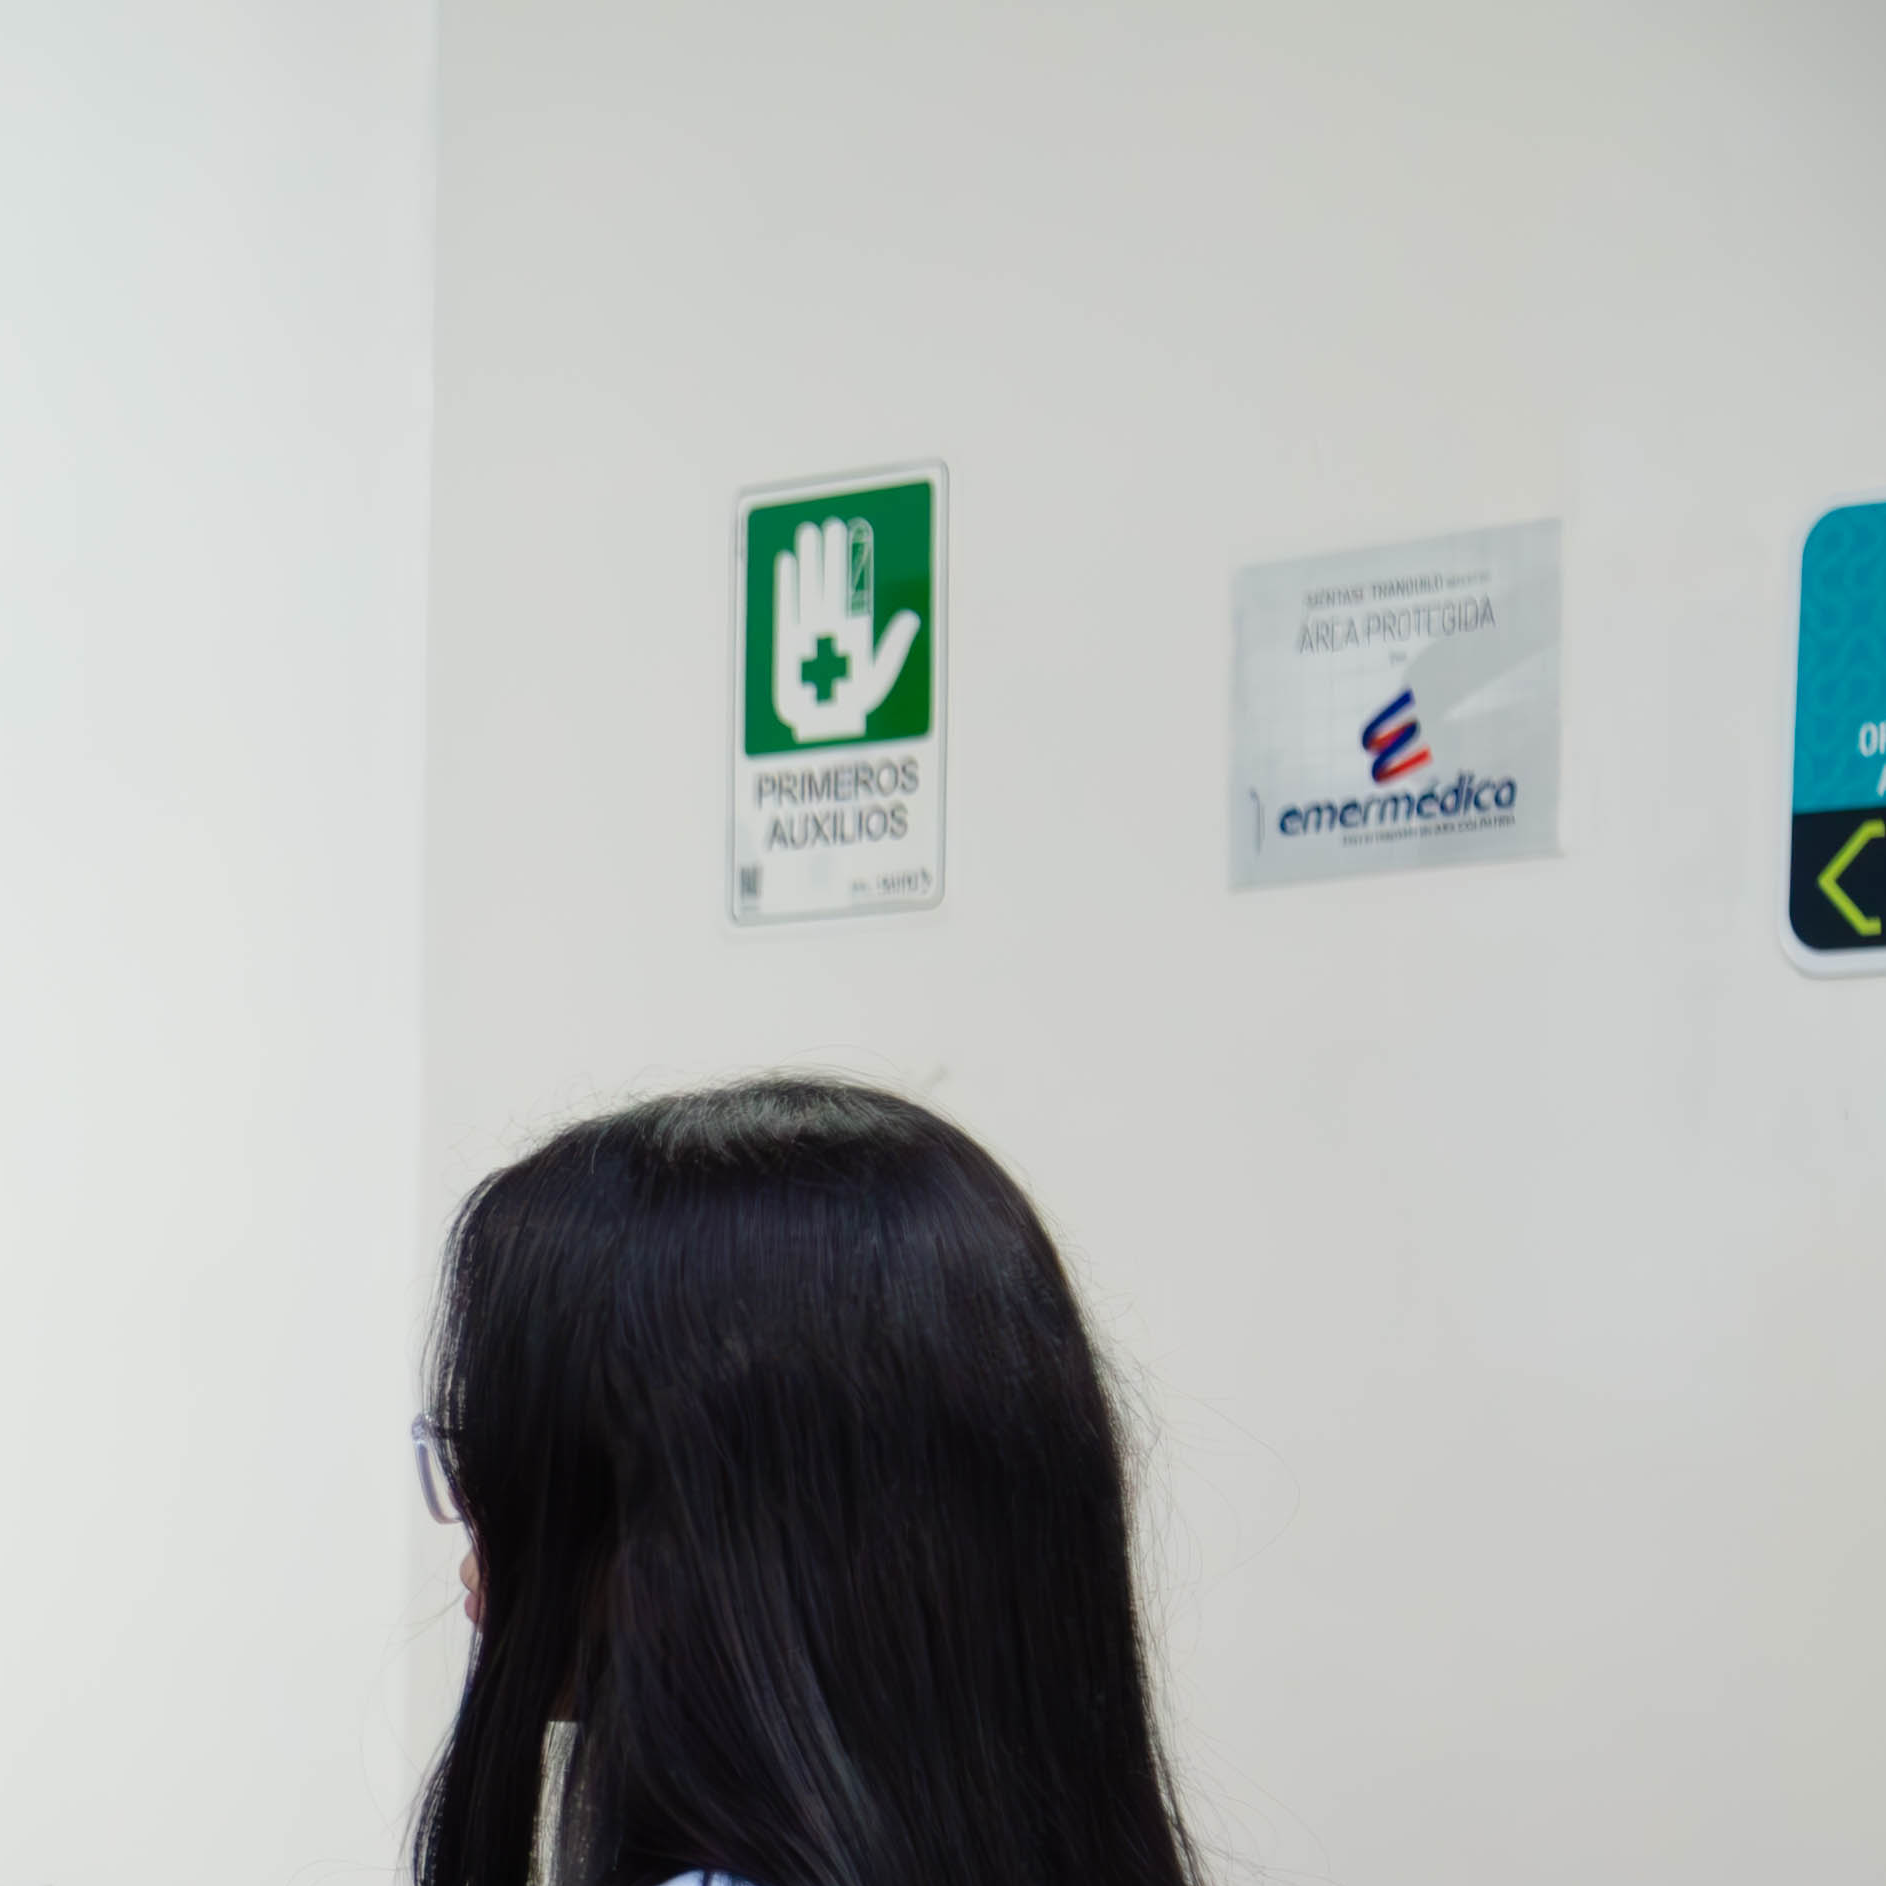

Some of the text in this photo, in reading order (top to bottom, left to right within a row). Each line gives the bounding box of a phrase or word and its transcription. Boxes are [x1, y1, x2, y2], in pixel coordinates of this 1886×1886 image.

[1364, 593, 1497, 648] PROTEGIDA
[754, 756, 919, 811] PRIMEROS
[1278, 769, 1517, 837] emermédica
[765, 802, 909, 851] AUXILIOS
